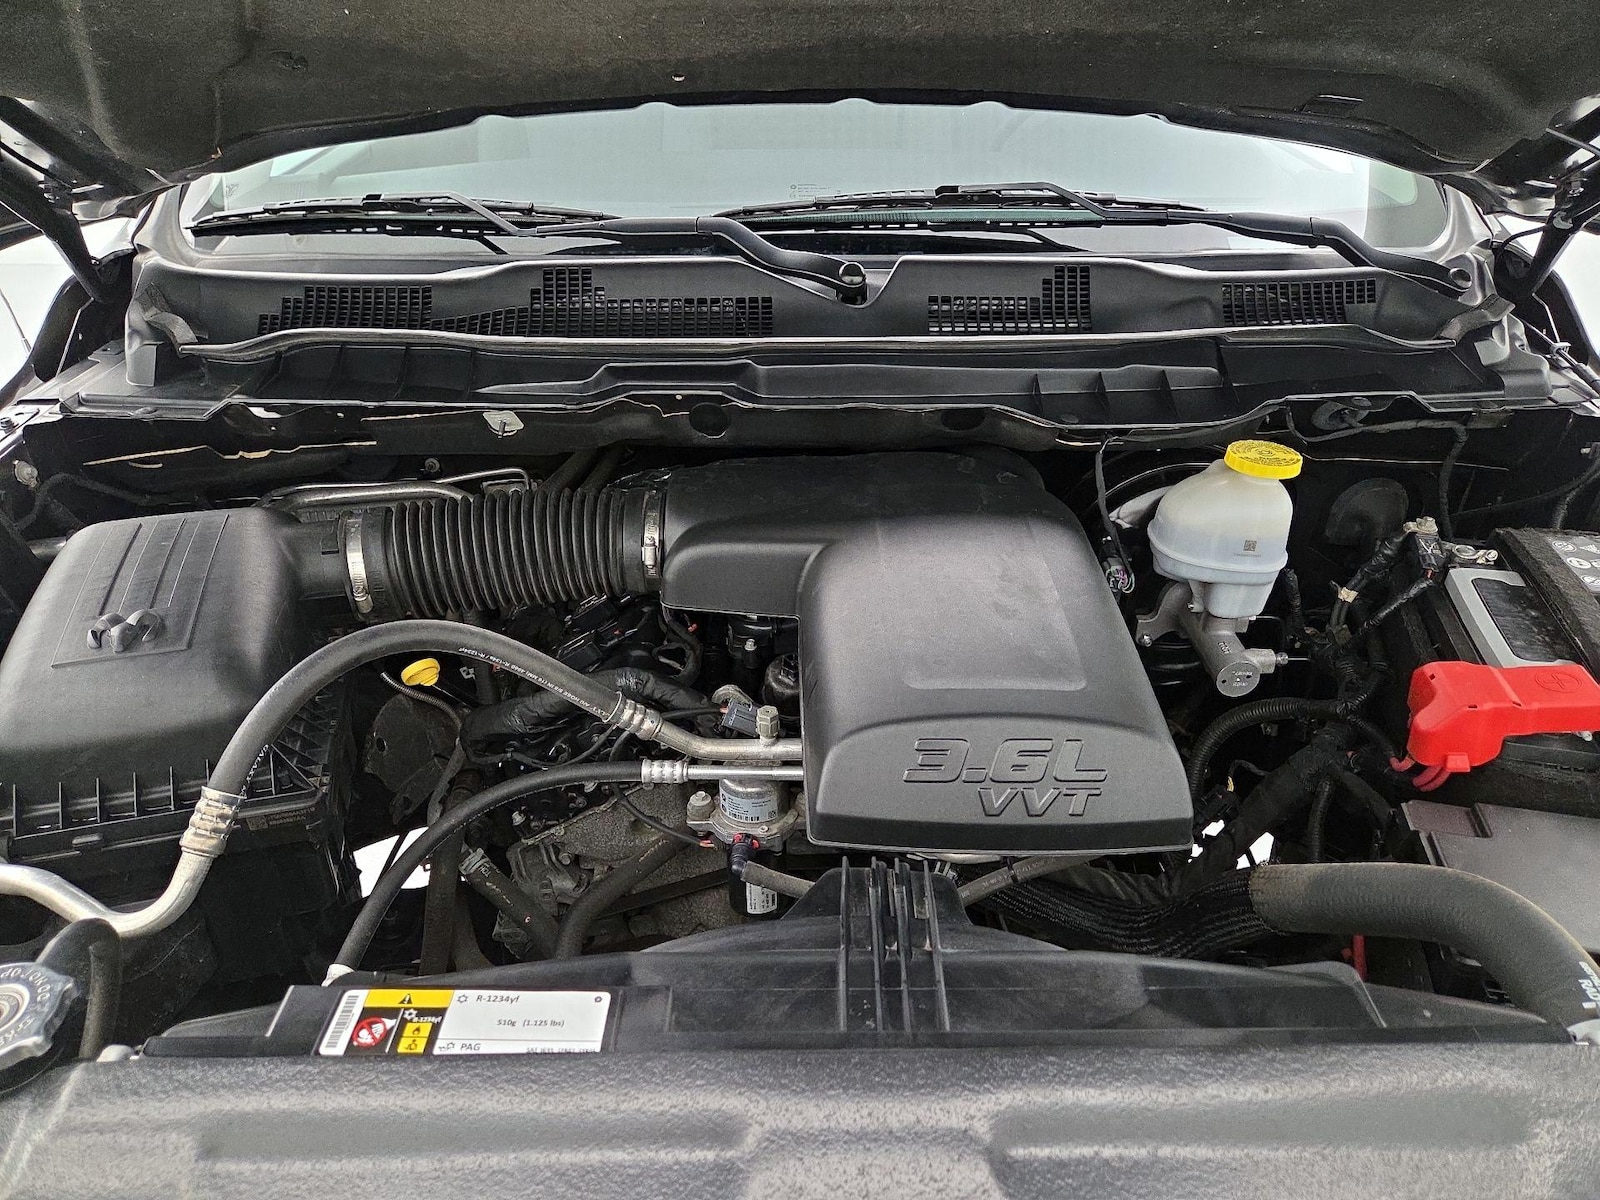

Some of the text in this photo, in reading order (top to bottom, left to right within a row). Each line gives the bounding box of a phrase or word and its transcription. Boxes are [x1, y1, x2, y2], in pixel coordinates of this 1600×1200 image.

[563, 690, 579, 702] HOSE
[246, 744, 269, 782] GALAXY
[903, 738, 1108, 783] 3.6L
[977, 787, 1102, 817] VVT
[476, 995, 521, 1004] R-1234yf
[496, 1019, 517, 1027] 510g
[522, 1019, 549, 1027] (1.125
[460, 1043, 481, 1051] PAG
